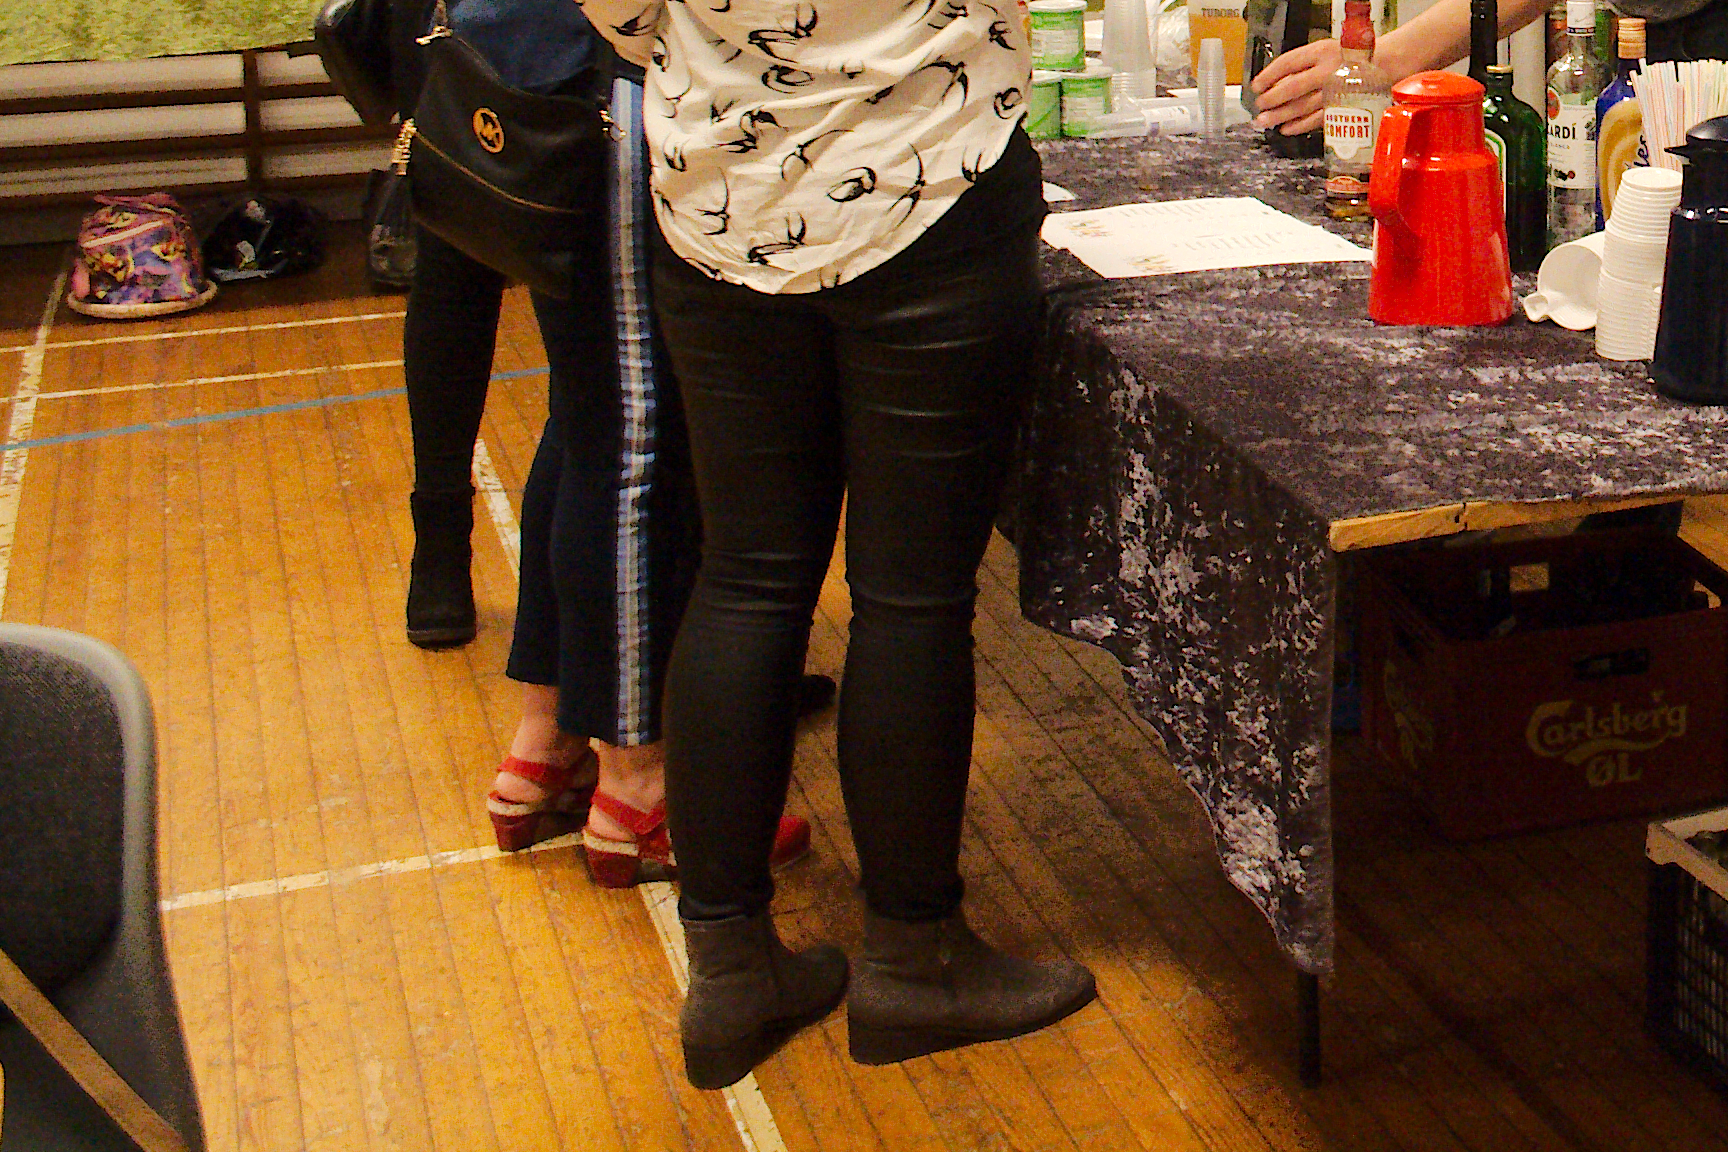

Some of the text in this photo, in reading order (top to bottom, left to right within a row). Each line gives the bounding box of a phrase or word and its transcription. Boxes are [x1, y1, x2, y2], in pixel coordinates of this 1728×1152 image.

[1200, 7, 1240, 18] TUBORG
[1325, 123, 1370, 138] COMFORT
[1547, 122, 1577, 140] ARDÍ
[1525, 696, 1688, 758] Carlsberg
[1585, 752, 1644, 788] ØL
